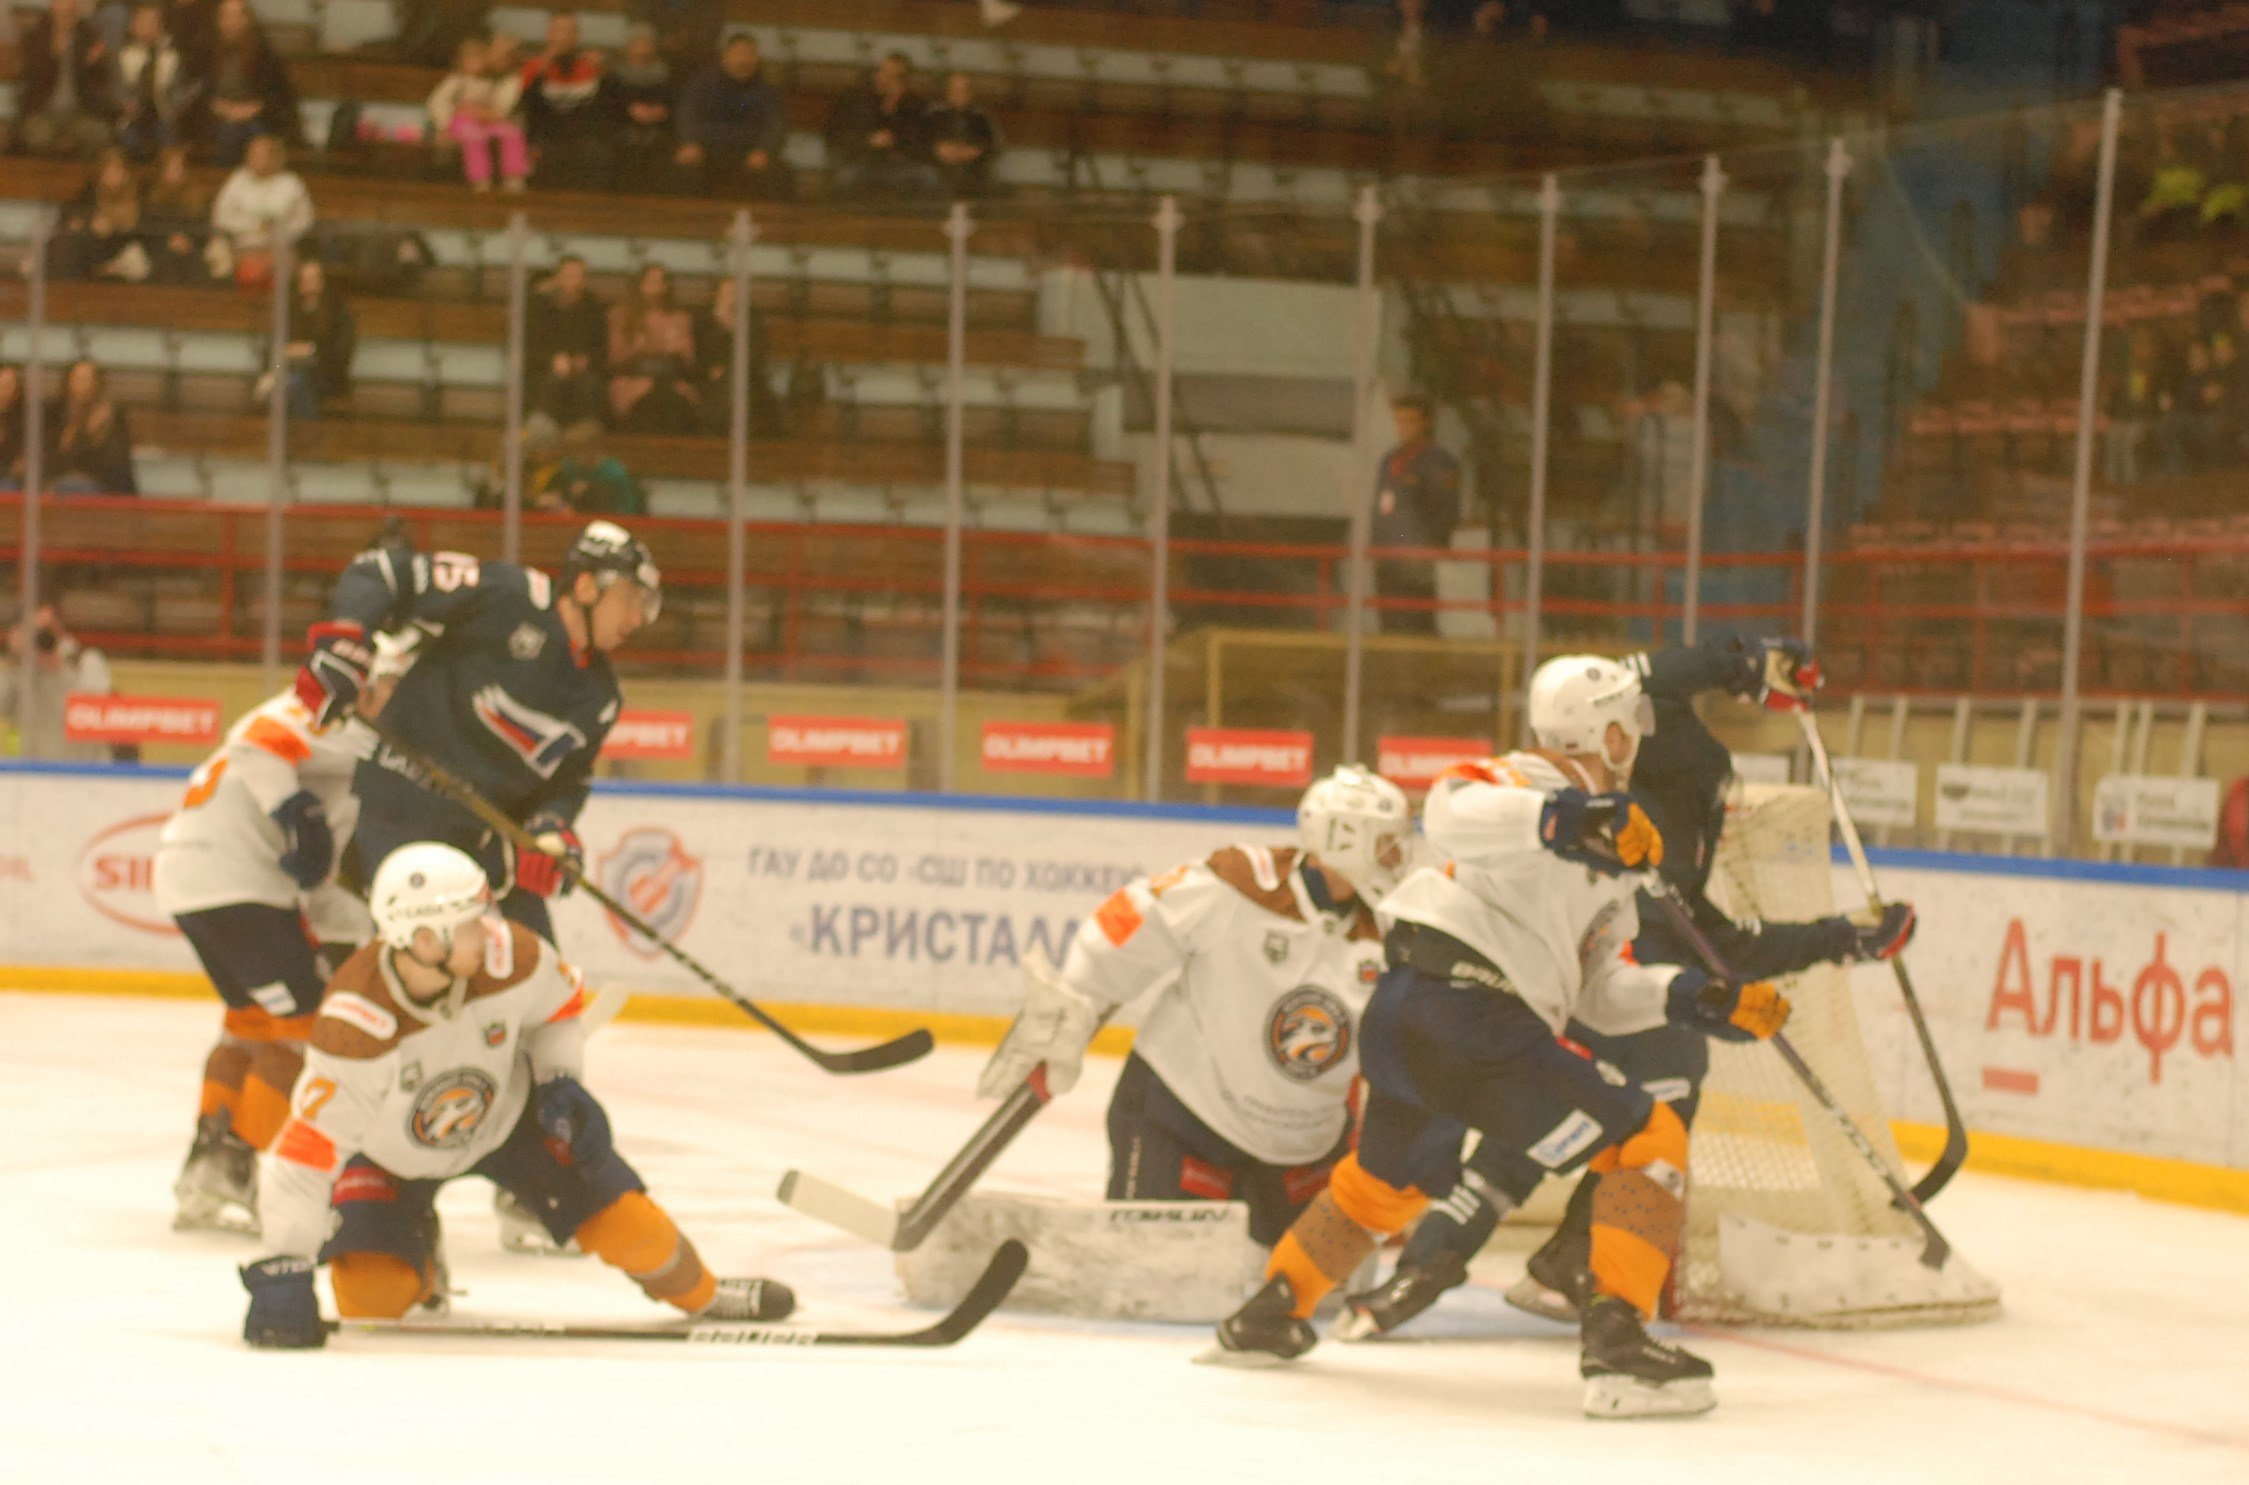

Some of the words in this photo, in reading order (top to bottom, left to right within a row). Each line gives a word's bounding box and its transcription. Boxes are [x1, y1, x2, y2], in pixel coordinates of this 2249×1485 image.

[66, 703, 214, 735] OLIMPBET
[602, 721, 689, 748] MPBET
[769, 726, 899, 756] OLIMPBET
[982, 734, 1109, 763] OLIMPBET
[1187, 742, 1309, 772] OLIMPBET
[747, 849, 801, 878] ГАУ
[856, 853, 898, 884] СО
[975, 857, 1016, 890] ПО
[1986, 916, 2233, 1086] Альфа
